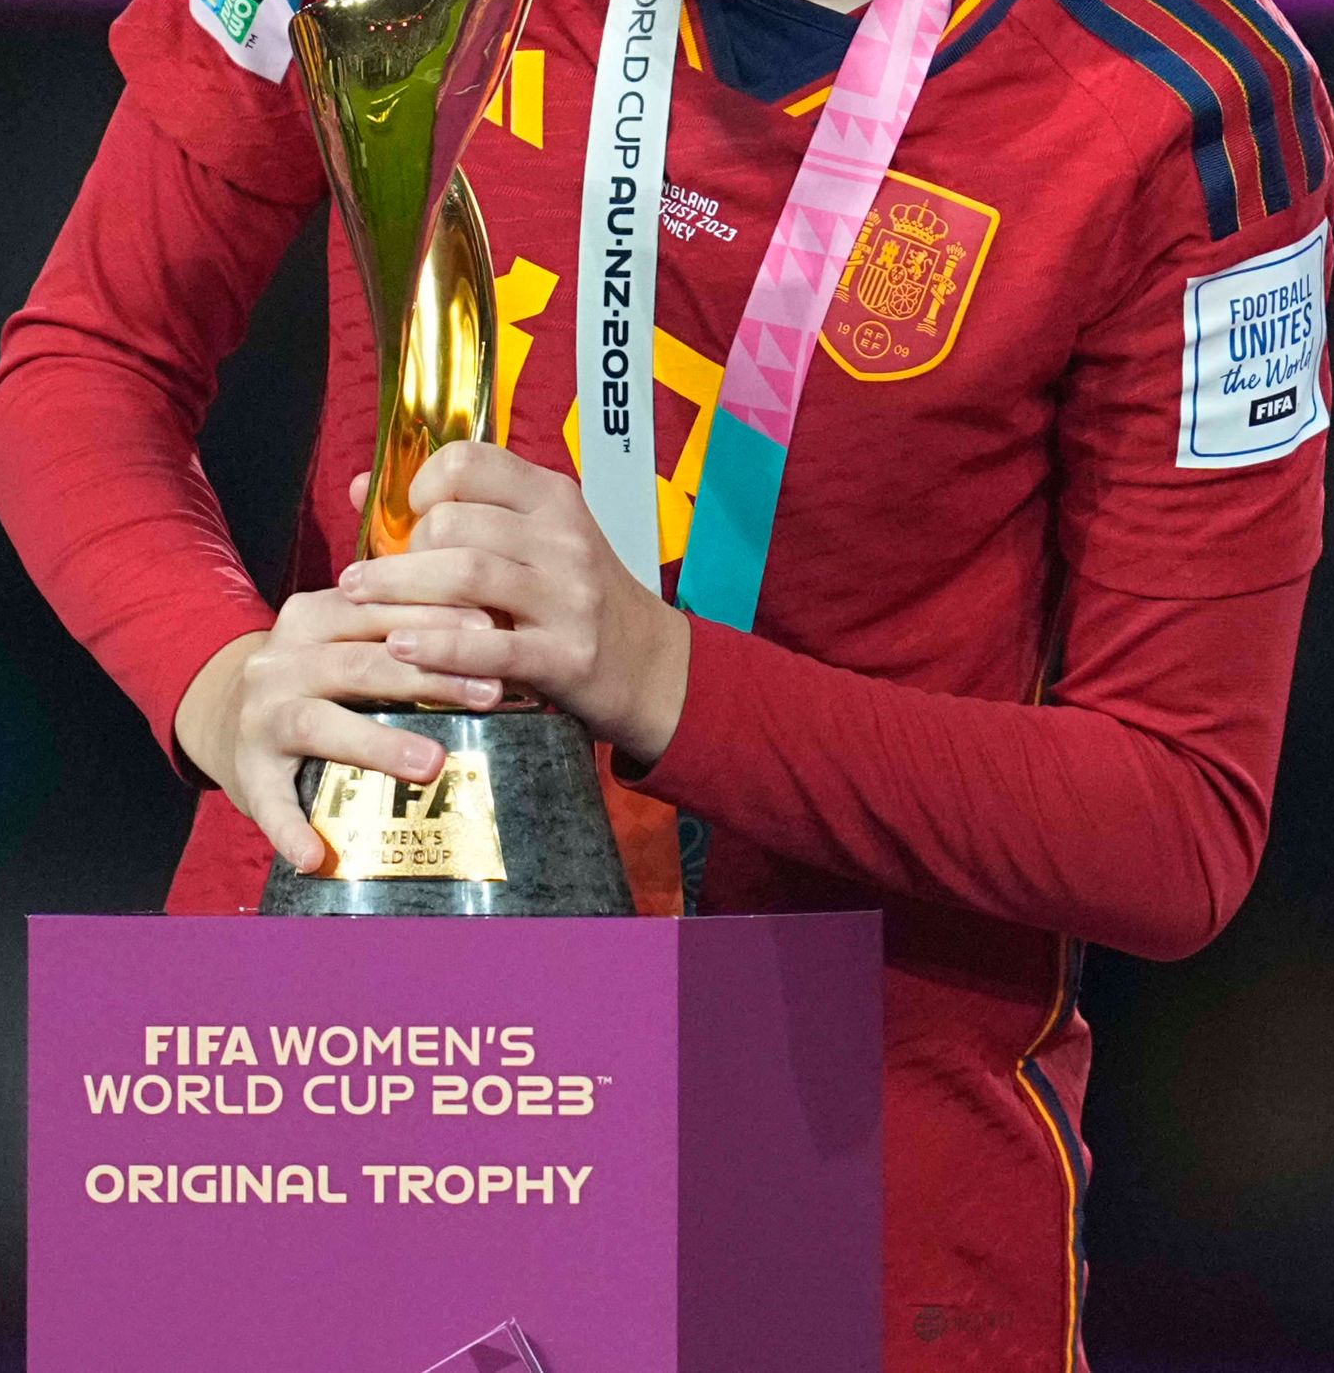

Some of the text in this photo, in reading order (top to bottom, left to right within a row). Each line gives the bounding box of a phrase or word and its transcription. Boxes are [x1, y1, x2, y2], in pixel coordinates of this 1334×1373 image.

[613, 91, 644, 170] CUP
[662, 180, 719, 216] NGLAND
[658, 196, 738, 242] GUST 2023
[662, 214, 696, 242] NEY
[1229, 274, 1312, 324] FOOTBALL
[837, 322, 851, 335] 19
[1229, 302, 1313, 363] UNITES
[893, 344, 910, 358] 09
[1220, 336, 1315, 395] the World
[1255, 395, 1293, 421] FIFA
[347, 829, 444, 845] WMEN'S
[412, 849, 453, 865] CUP
[145, 1026, 536, 1067] FIFA WOMEN'S
[83, 1074, 284, 1115] WORLD
[302, 1075, 415, 1115] CUP
[85, 1164, 594, 1204] ORIGINAL TROPHY
